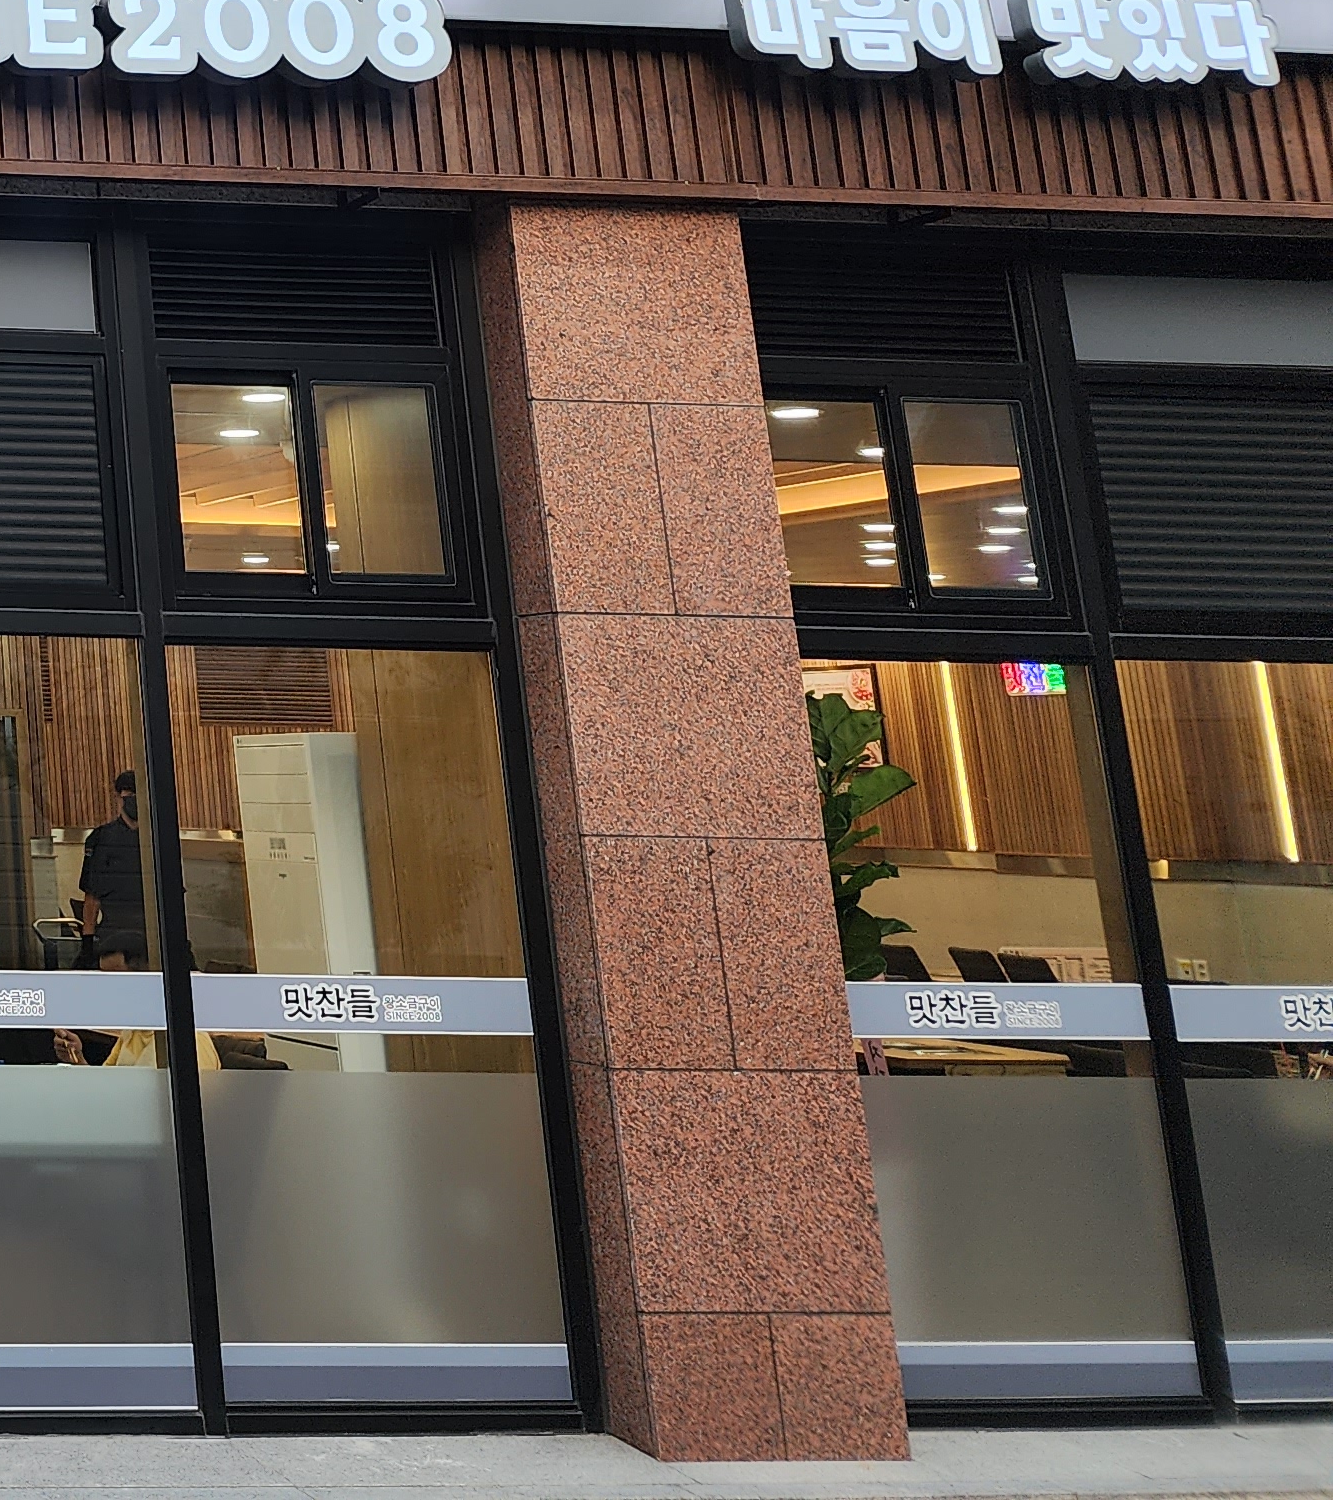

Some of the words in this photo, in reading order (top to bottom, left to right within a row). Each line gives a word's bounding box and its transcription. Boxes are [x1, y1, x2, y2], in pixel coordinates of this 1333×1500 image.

[20, 1005, 46, 1016] 2008
[282, 983, 378, 1022] 맛찬들
[908, 993, 1000, 1025] 맛찬들
